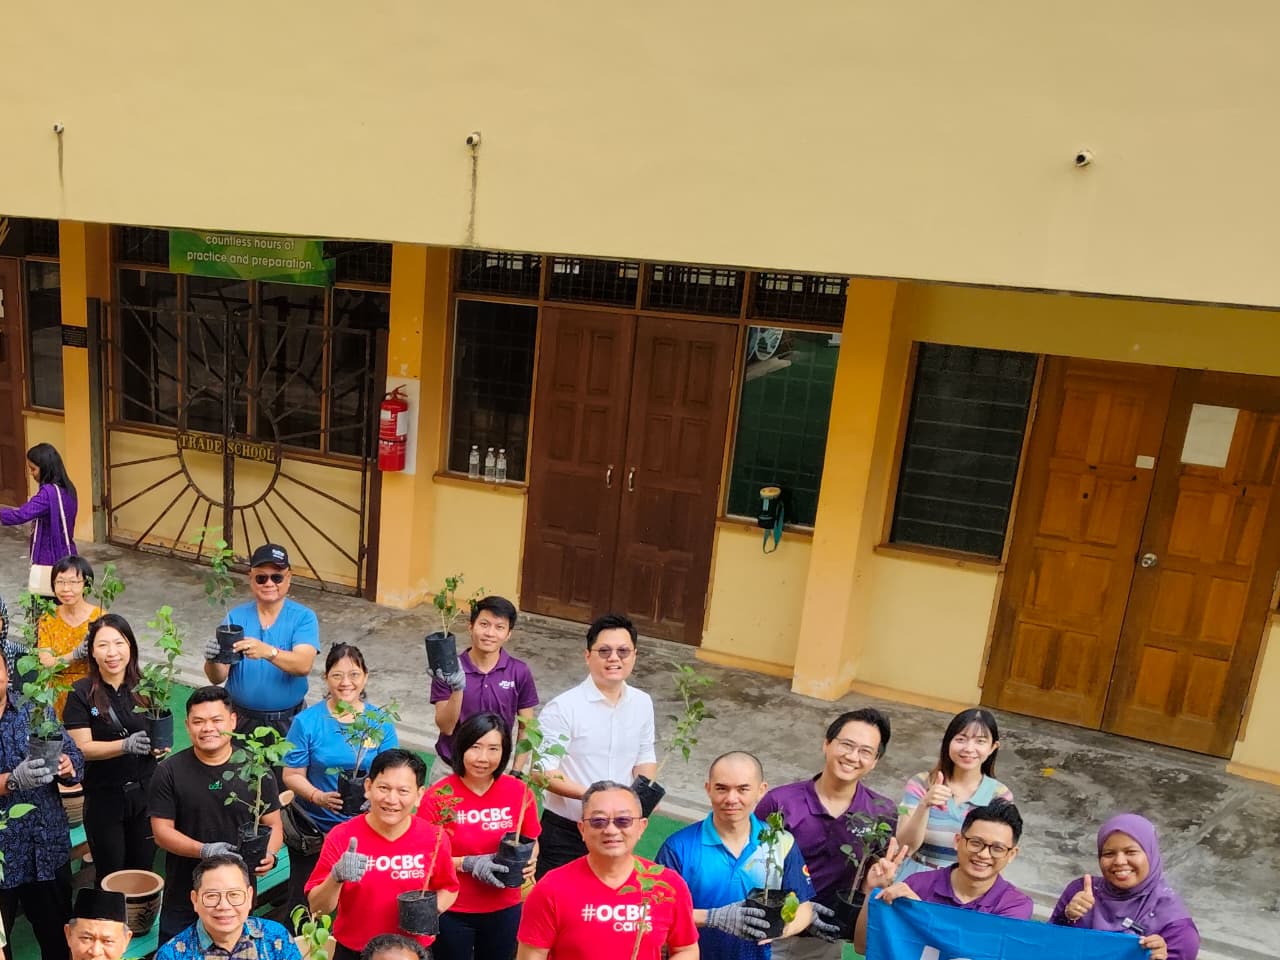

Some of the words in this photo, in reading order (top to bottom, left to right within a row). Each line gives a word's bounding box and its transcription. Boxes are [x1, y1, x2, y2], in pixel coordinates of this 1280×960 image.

[205, 235, 252, 248] countless
[186, 250, 227, 263] practice
[229, 254, 249, 264] and
[251, 255, 315, 270] preparation.
[180, 434, 222, 453] TRADE
[227, 441, 275, 461] SCHOOL
[457, 807, 512, 824] #OCBC
[482, 819, 513, 831] cares
[366, 854, 425, 872] #OCBC
[391, 868, 425, 880] cares
[581, 903, 652, 922] #OCBC
[613, 921, 653, 932] cars
